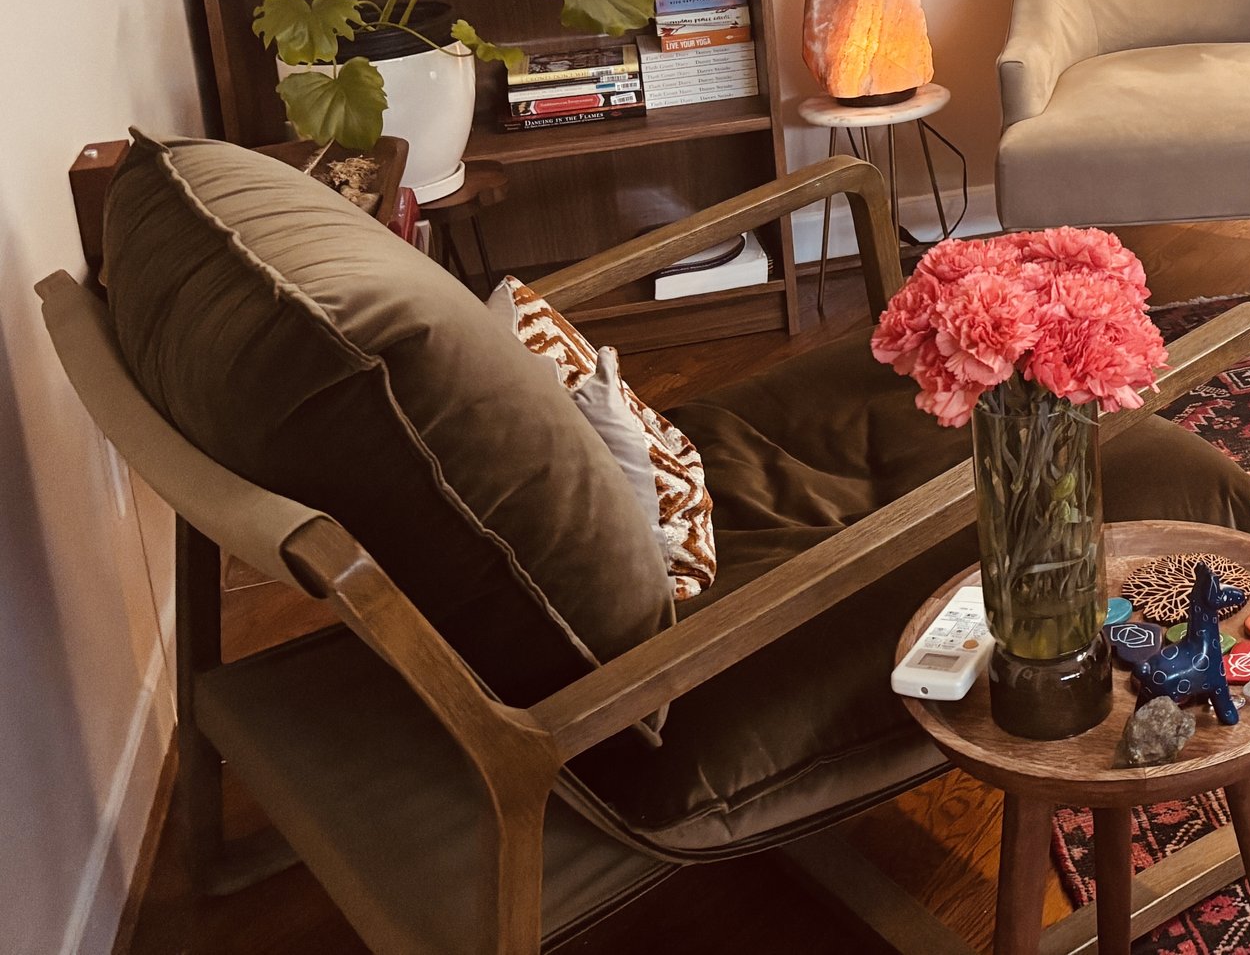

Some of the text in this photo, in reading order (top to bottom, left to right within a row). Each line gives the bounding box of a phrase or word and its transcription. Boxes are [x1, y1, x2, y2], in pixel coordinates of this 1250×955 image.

[666, 37, 711, 50] LIVE YOUR YOGA
[579, 111, 603, 119] FLAMES
